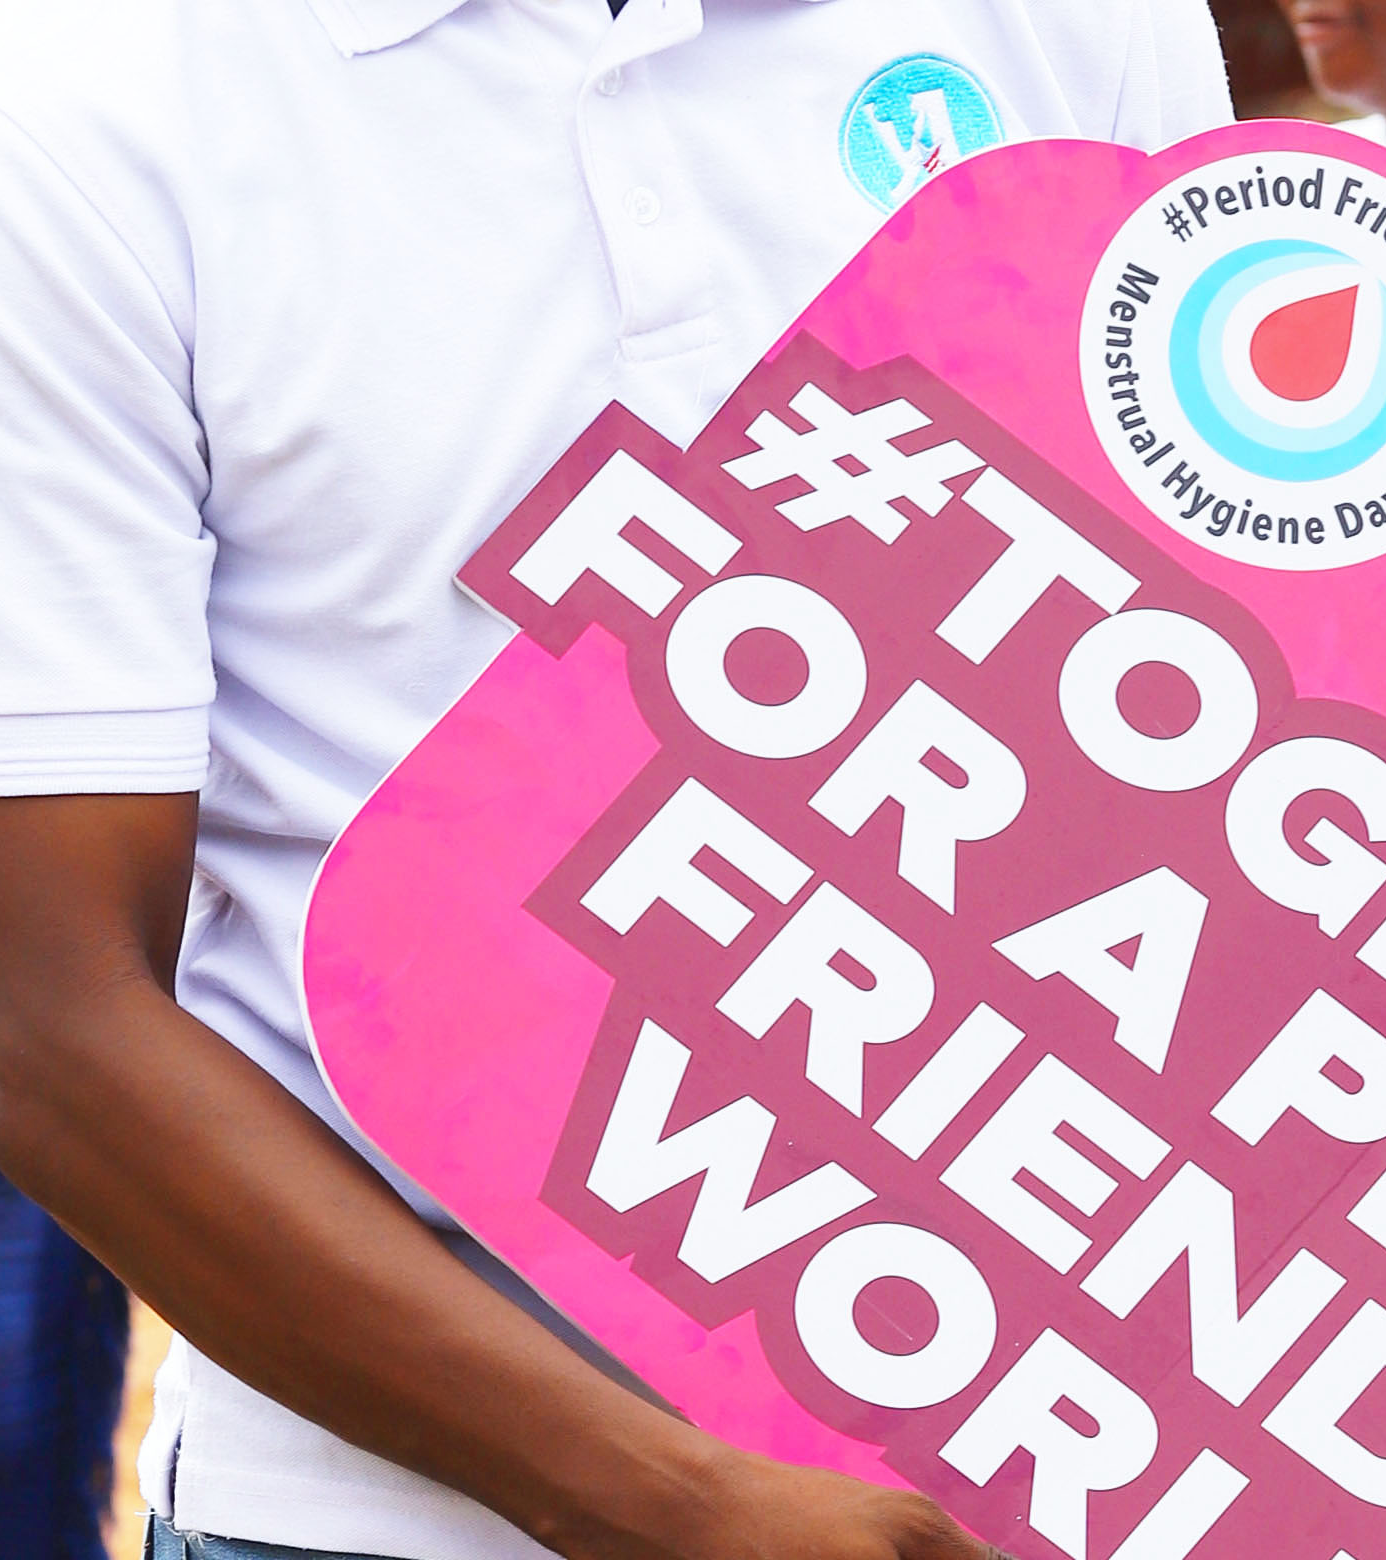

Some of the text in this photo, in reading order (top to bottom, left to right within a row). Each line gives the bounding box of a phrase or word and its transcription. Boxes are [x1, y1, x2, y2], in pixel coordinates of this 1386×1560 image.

[1161, 166, 1325, 243] #Period
[1104, 261, 1176, 468] Menstrual
[1160, 460, 1326, 546] Hygiene
[507, 447, 1028, 916] FOR
[990, 864, 1210, 1076] A
